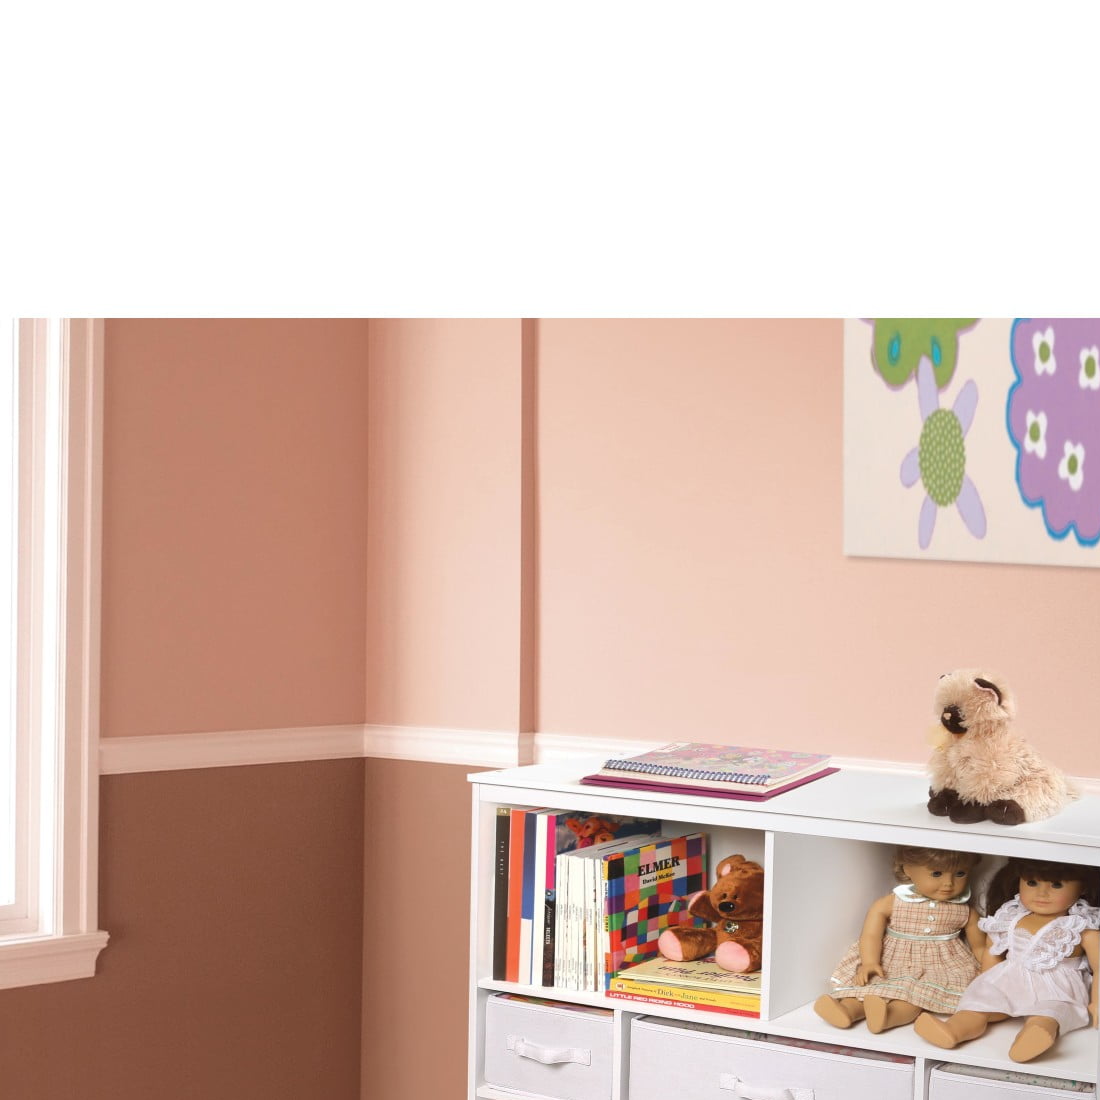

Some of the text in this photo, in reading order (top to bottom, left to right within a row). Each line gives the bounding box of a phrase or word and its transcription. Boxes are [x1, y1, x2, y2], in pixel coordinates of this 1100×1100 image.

[637, 856, 680, 877] ELMER
[642, 875, 658, 885] David
[609, 992, 633, 1000] LITTLE
[648, 997, 673, 1006] RIDING
[673, 1001, 695, 1009] HOOD
[657, 989, 674, 997] Dick
[681, 993, 698, 1001] Jane
